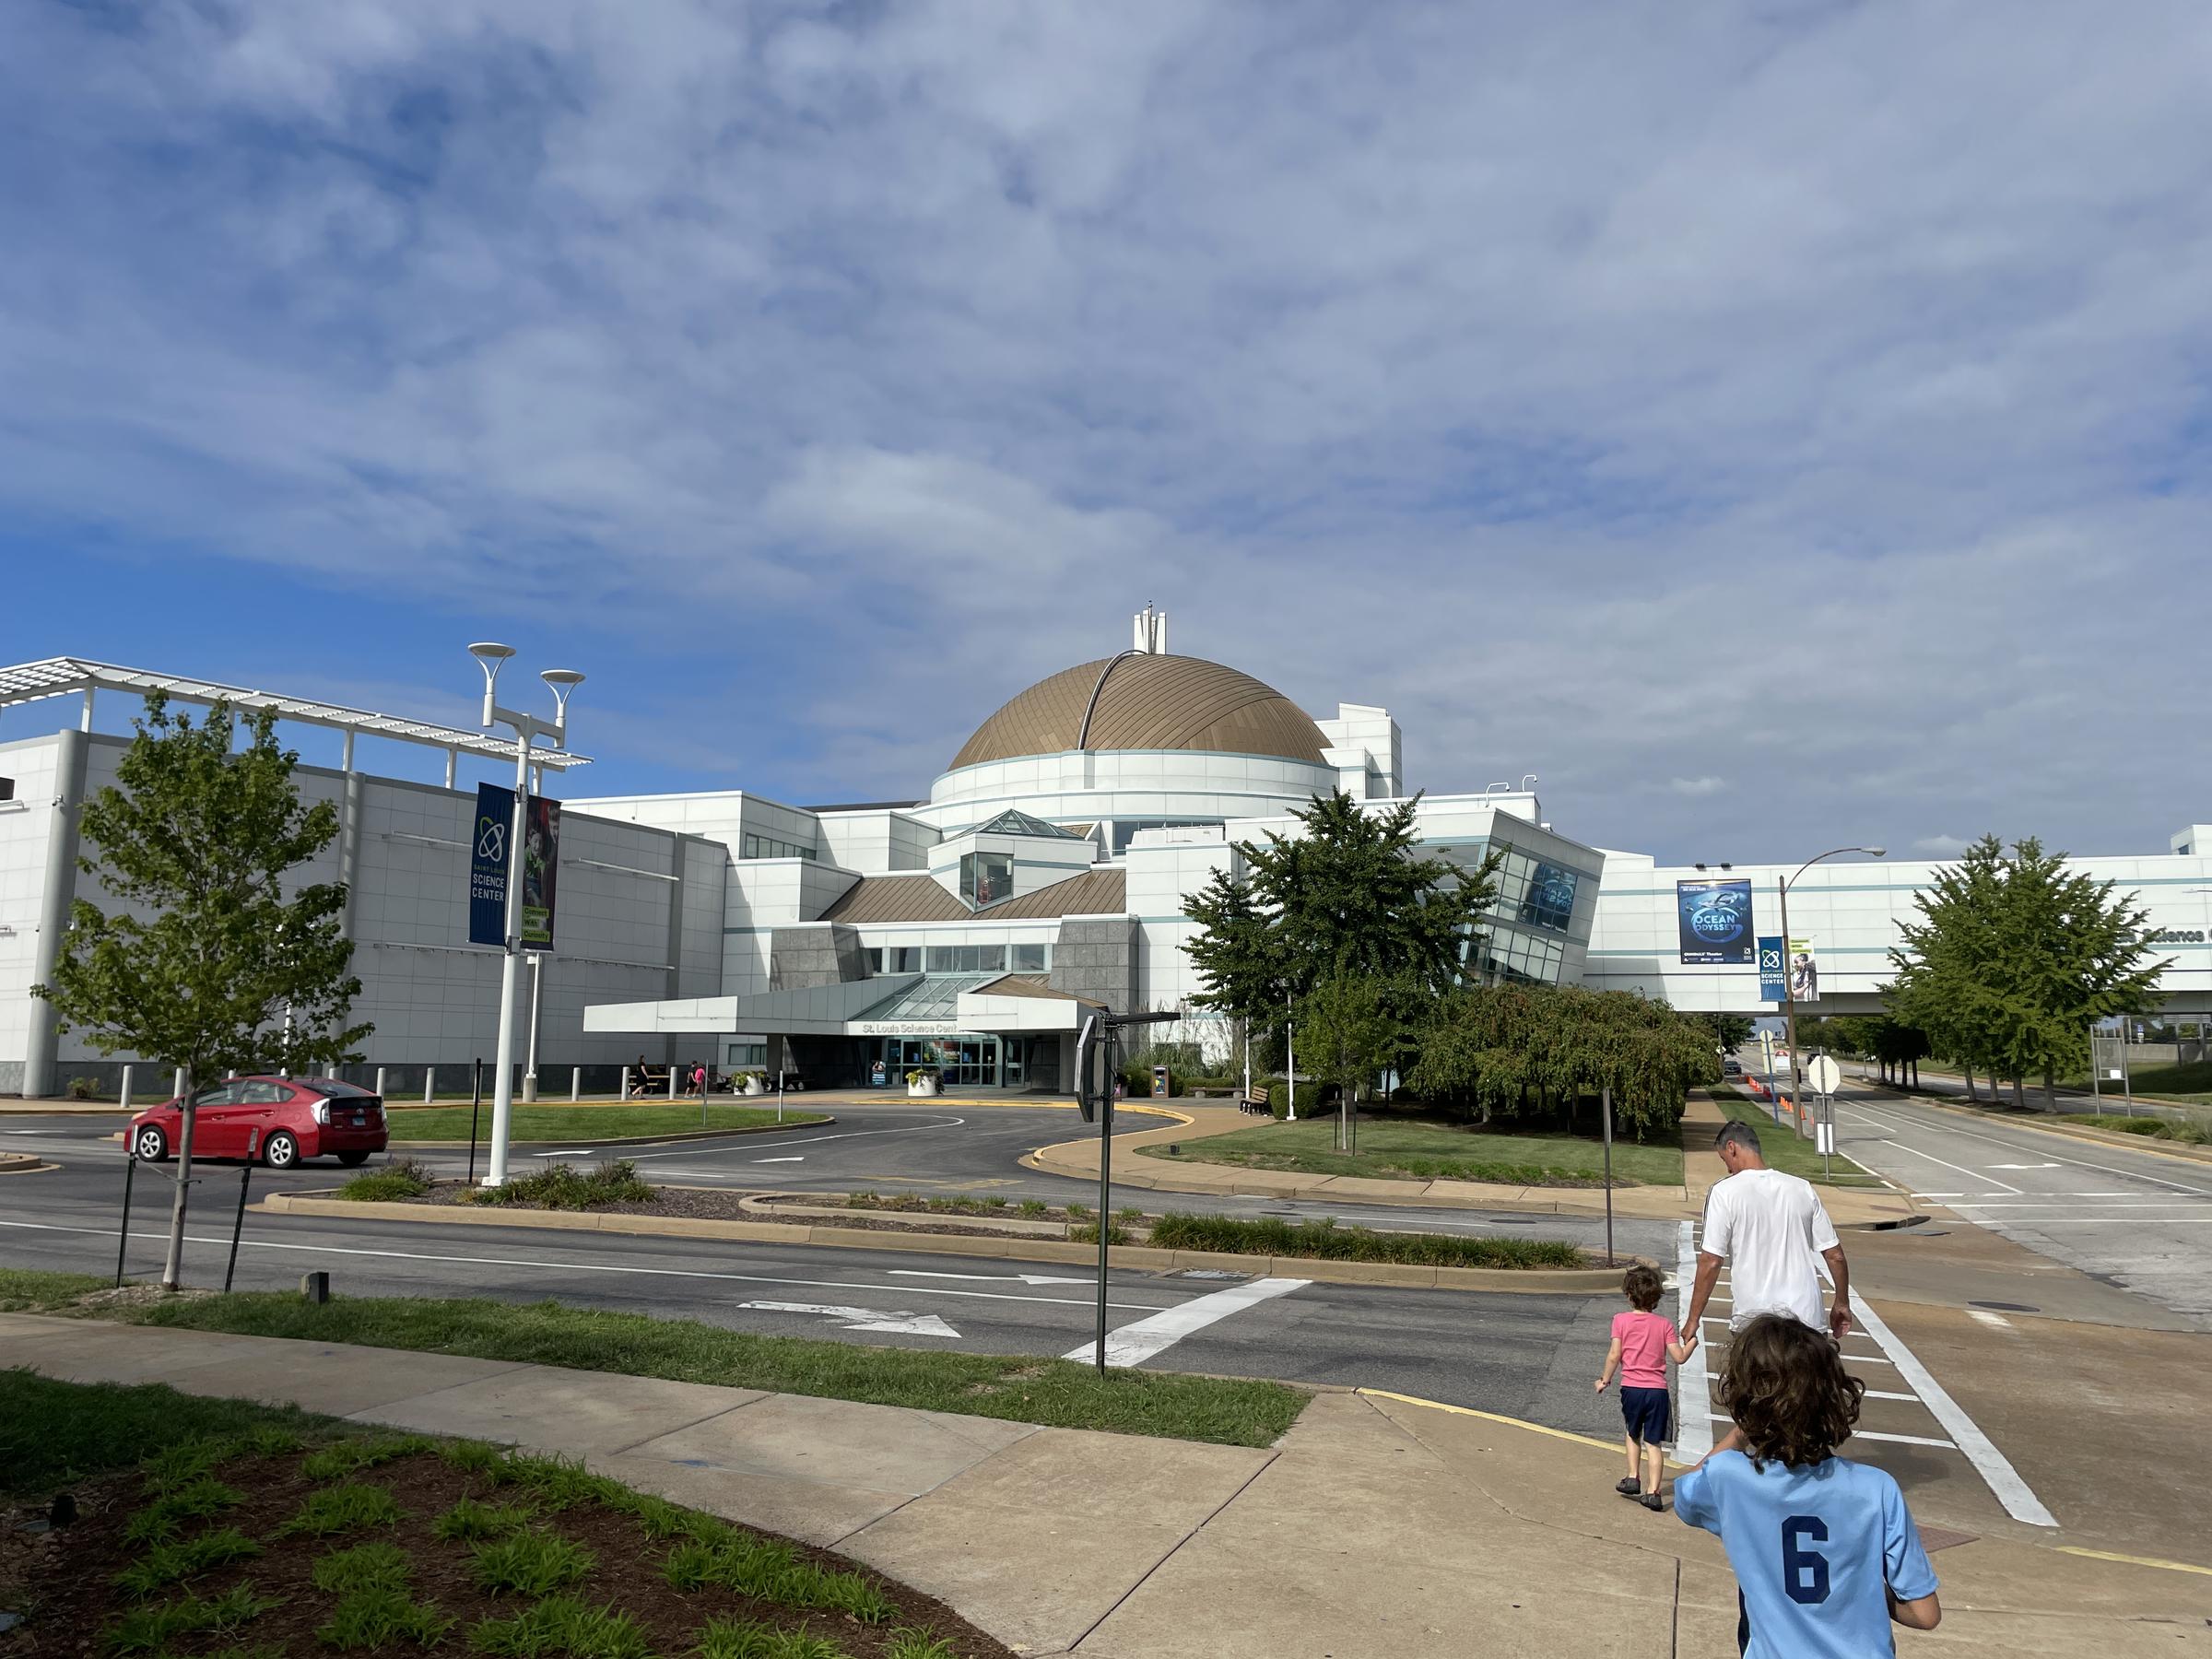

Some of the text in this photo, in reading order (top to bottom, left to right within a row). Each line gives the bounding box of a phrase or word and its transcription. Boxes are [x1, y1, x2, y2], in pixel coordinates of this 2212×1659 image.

[473, 873, 504, 888] SCIENCE
[472, 887, 504, 901] CENTER
[1696, 915, 1735, 924] OCEAN
[863, 1024, 875, 1033] St.
[877, 1024, 900, 1033] Louis
[900, 1024, 935, 1033] Science
[1782, 1515, 1830, 1605] 6
